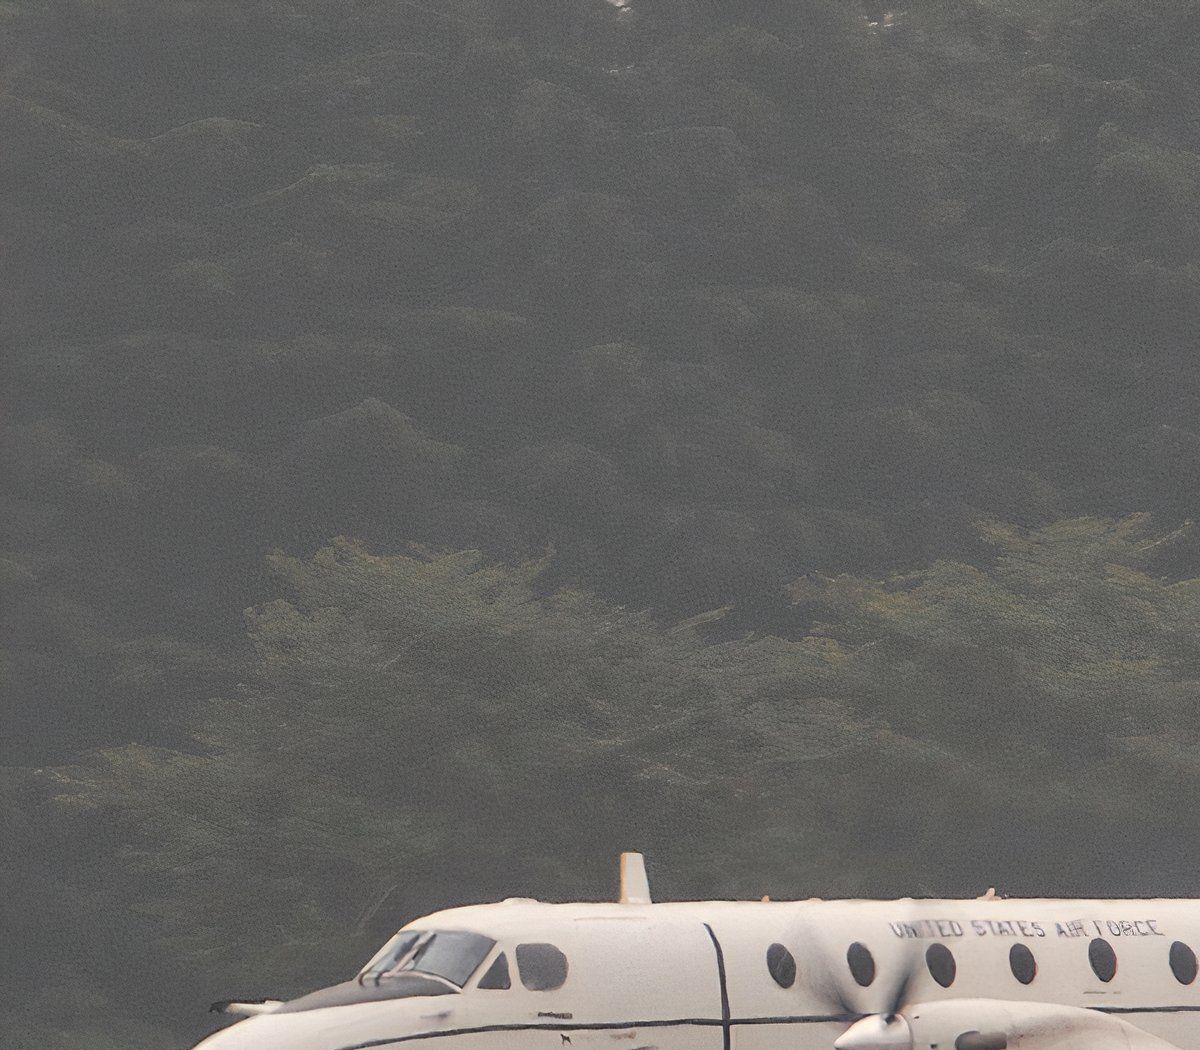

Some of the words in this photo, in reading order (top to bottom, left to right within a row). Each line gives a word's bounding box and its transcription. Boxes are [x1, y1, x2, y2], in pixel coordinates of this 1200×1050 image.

[889, 919, 964, 938] UNITED
[970, 919, 1046, 938] STATES
[1055, 919, 1089, 937] AIR
[1092, 919, 1166, 937] FORCE
